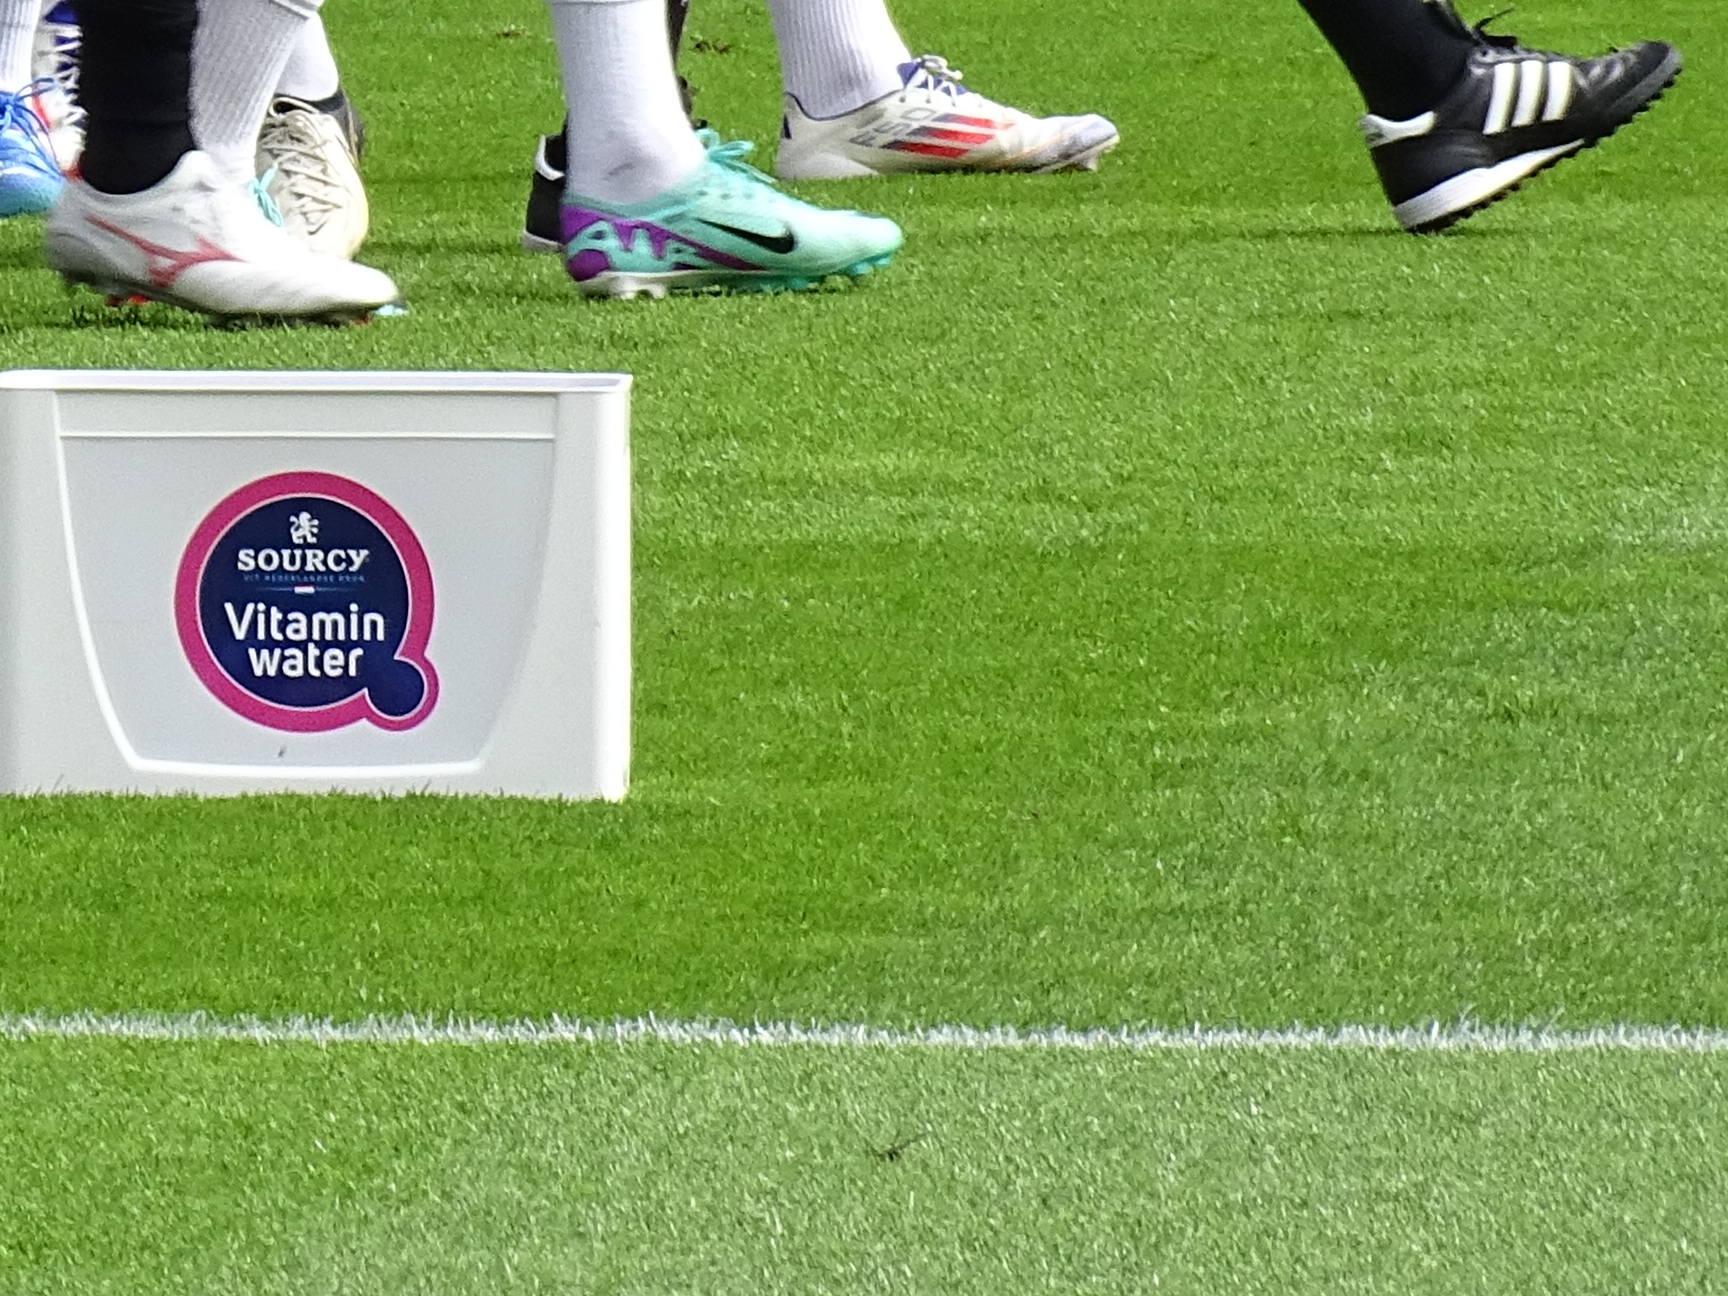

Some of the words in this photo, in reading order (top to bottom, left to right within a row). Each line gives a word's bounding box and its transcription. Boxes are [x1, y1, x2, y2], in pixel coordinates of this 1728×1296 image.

[237, 548, 370, 572] SOURCY
[224, 601, 386, 642] Vitamin
[248, 642, 364, 677] water
